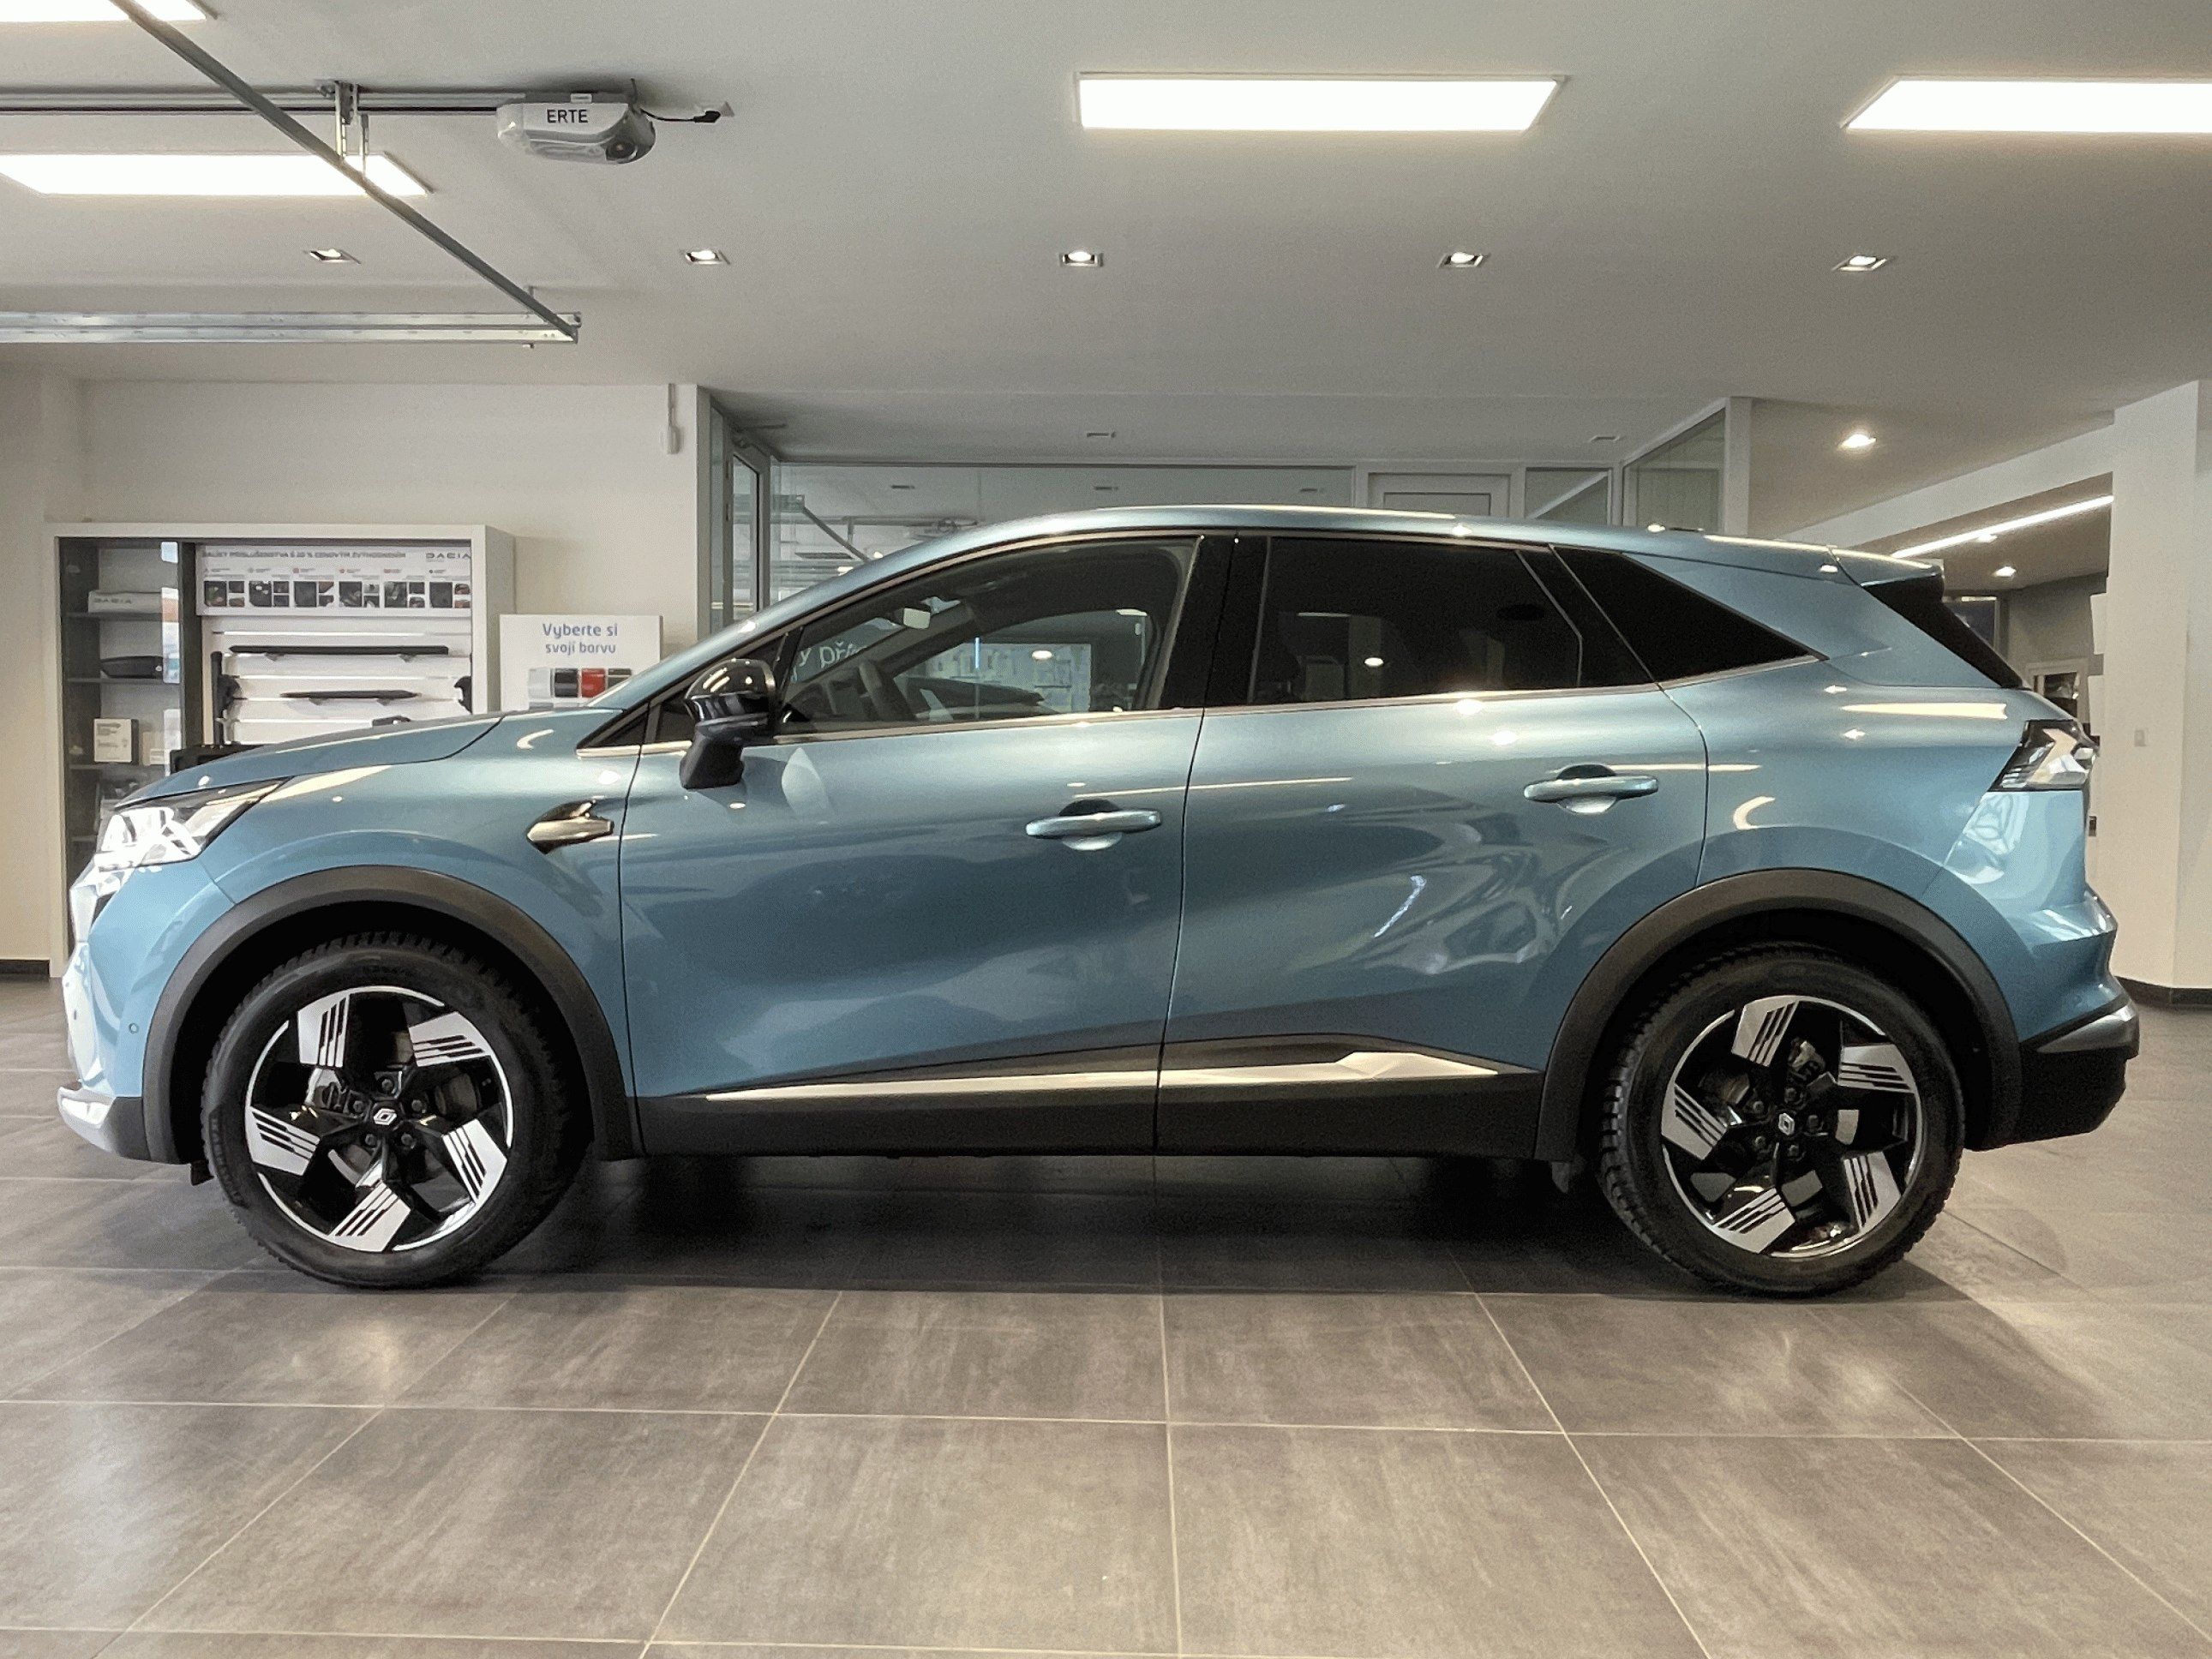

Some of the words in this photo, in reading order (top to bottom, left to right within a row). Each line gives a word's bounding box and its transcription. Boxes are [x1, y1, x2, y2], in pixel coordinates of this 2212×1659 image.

[546, 108, 589, 123] ERTE
[542, 623, 602, 638] Vyberte
[606, 623, 619, 637] si
[545, 642, 576, 656] svoji
[578, 642, 616, 655] barvu
